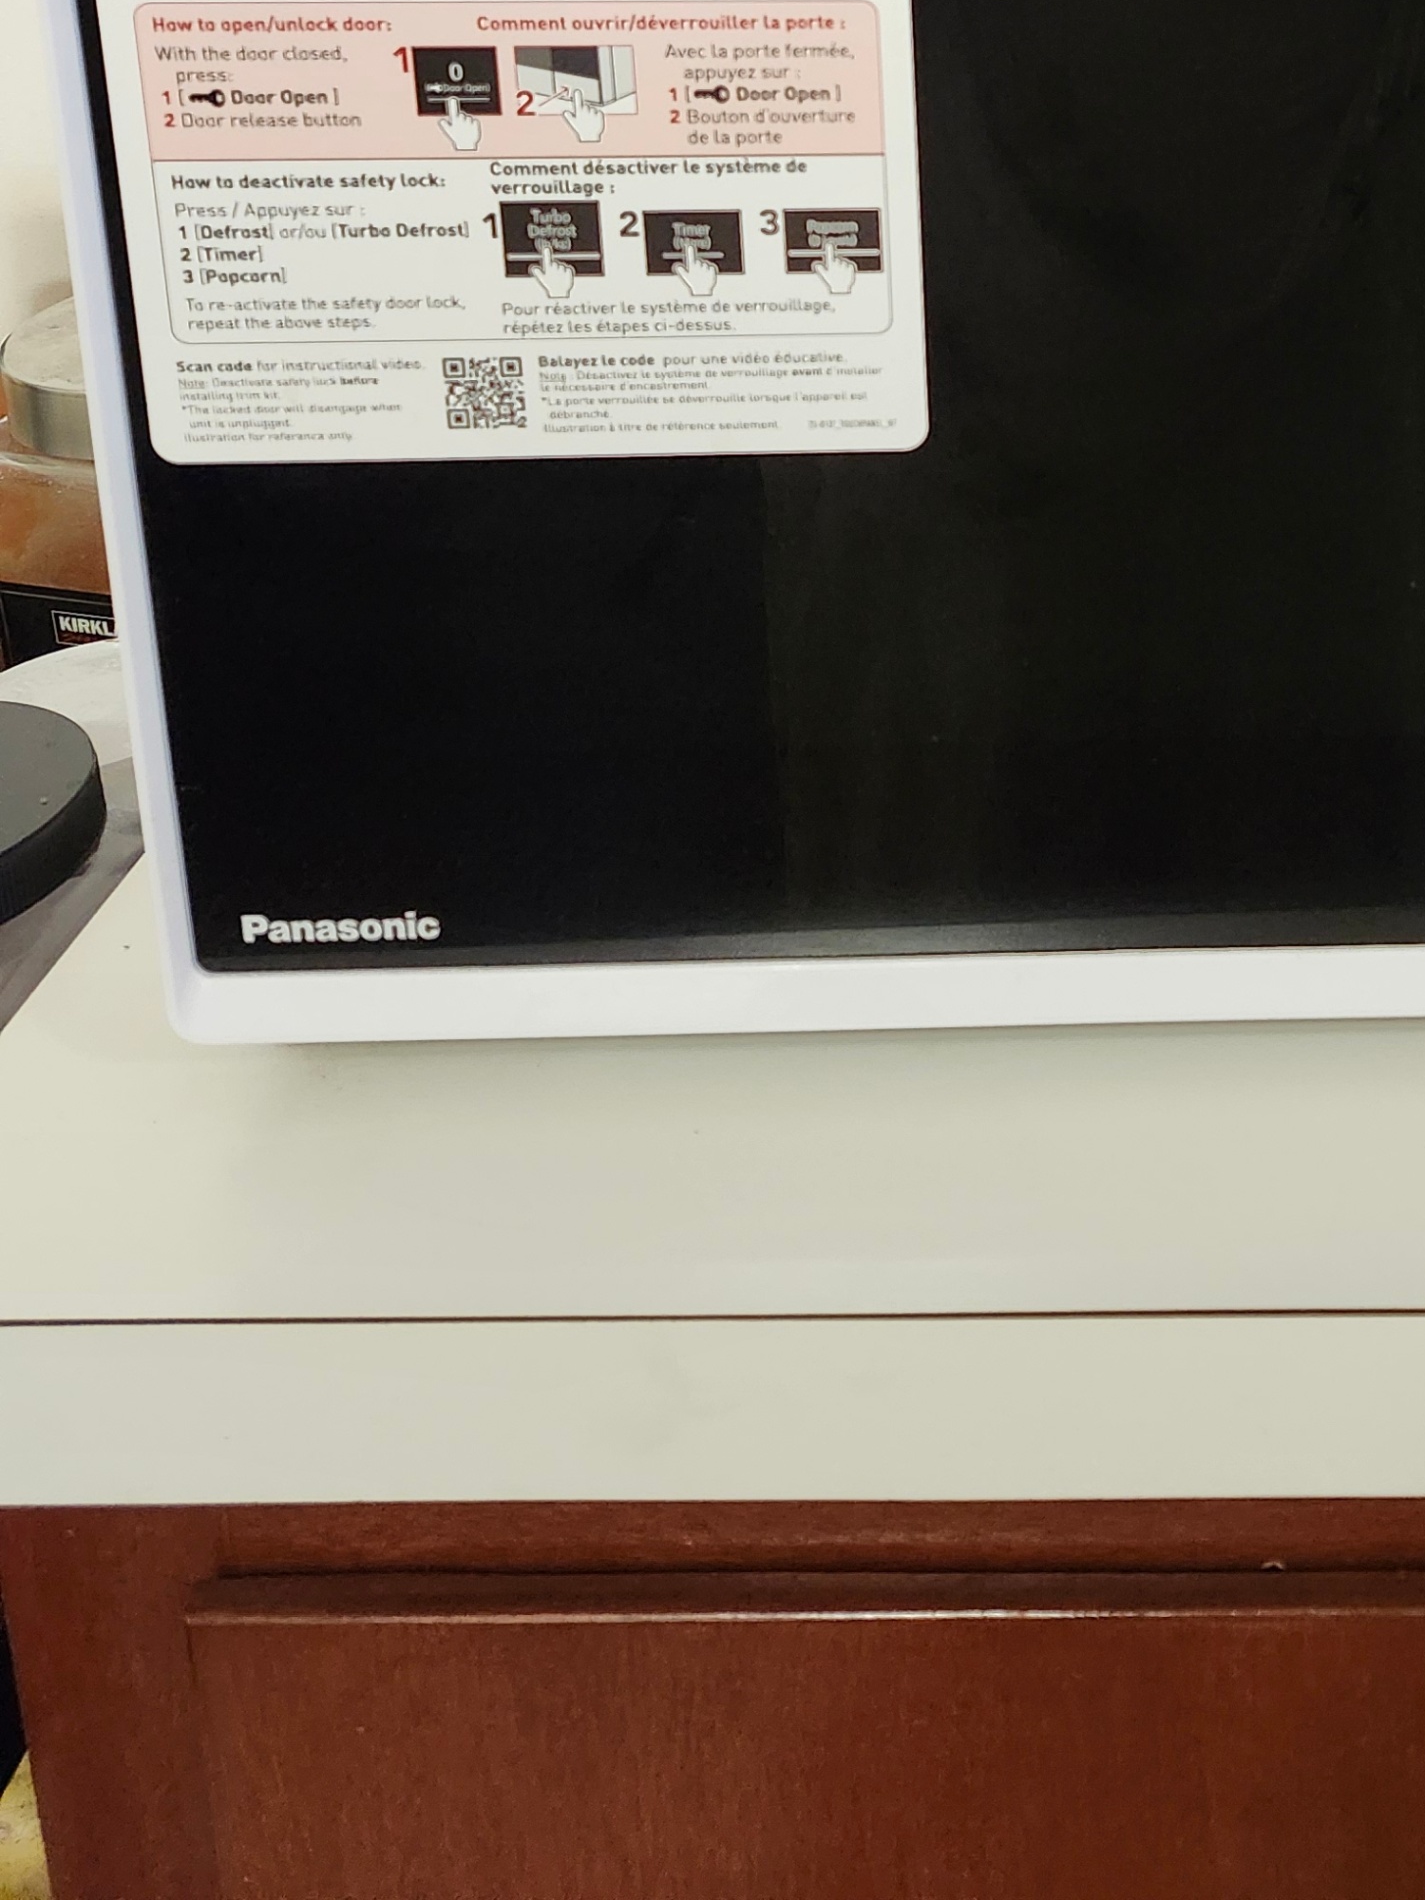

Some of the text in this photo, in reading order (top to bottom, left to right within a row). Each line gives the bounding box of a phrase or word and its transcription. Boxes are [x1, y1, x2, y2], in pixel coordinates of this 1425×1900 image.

[152, 15, 392, 36] How to open/unlock door:
[476, 14, 835, 33] Comment ouvrir/déverrouiller la porte
[154, 45, 348, 63] With the door closed,
[392, 46, 409, 74] 1
[448, 61, 464, 82] 0
[162, 89, 329, 107] 1 Door Open
[515, 91, 536, 117] 2
[668, 86, 831, 103] 1 Door Open
[163, 112, 362, 129] 2 Door release button
[490, 158, 808, 178] Comment désactiver le système de
[170, 172, 446, 191] How to deactivate safety lock:
[490, 179, 604, 198] verrouillage
[174, 202, 355, 221] Press Appuyez sur
[530, 208, 571, 225] Turbo
[482, 212, 498, 239] 1
[527, 223, 578, 239] Defrost
[619, 210, 640, 238] 2
[759, 209, 780, 236] 3
[178, 225, 187, 240] 1
[179, 245, 264, 264] 2 [Timer]
[182, 266, 288, 287] 3 [Popcorn]
[537, 355, 598, 370] Balayez
[600, 354, 617, 367] le
[619, 353, 656, 367] code
[662, 355, 696, 369] pour
[700, 355, 728, 365] une
[731, 353, 770, 364] vidéo
[58, 616, 117, 637] KIRKL
[240, 910, 442, 944] Panasonic
